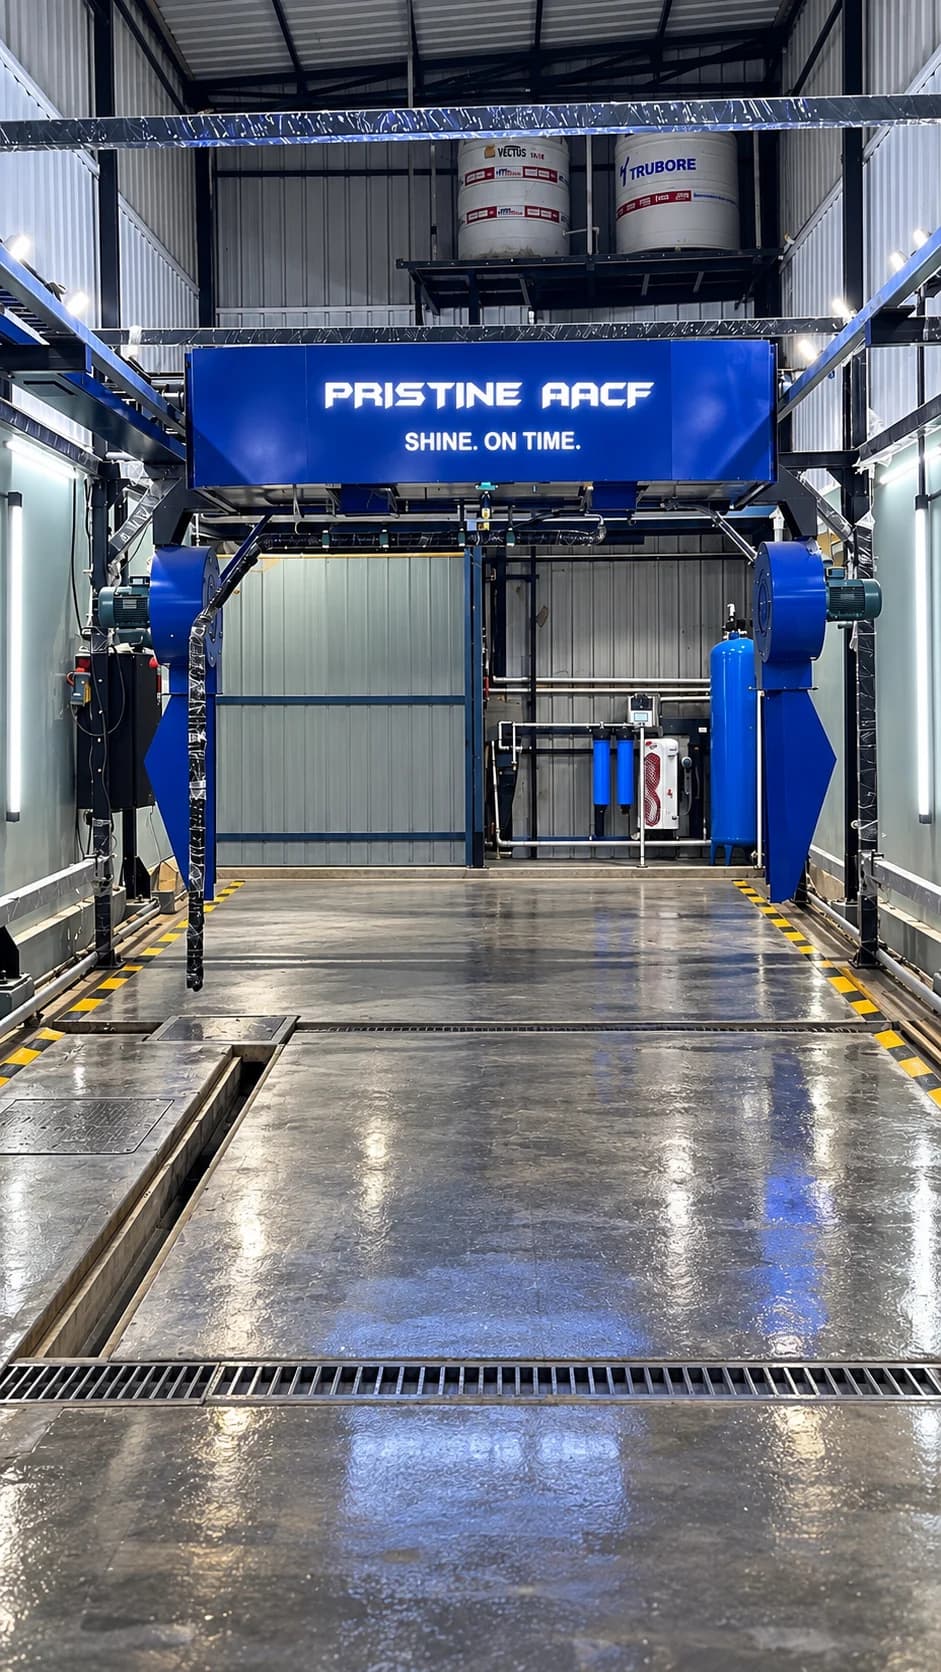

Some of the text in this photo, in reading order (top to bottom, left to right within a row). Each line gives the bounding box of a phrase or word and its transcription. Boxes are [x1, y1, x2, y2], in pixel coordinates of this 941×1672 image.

[497, 145, 527, 158] VECTUS
[630, 158, 697, 180] TRUBORE
[324, 382, 655, 410] PRISTINE AACF
[405, 431, 581, 452] SHINE. ON TIME.
